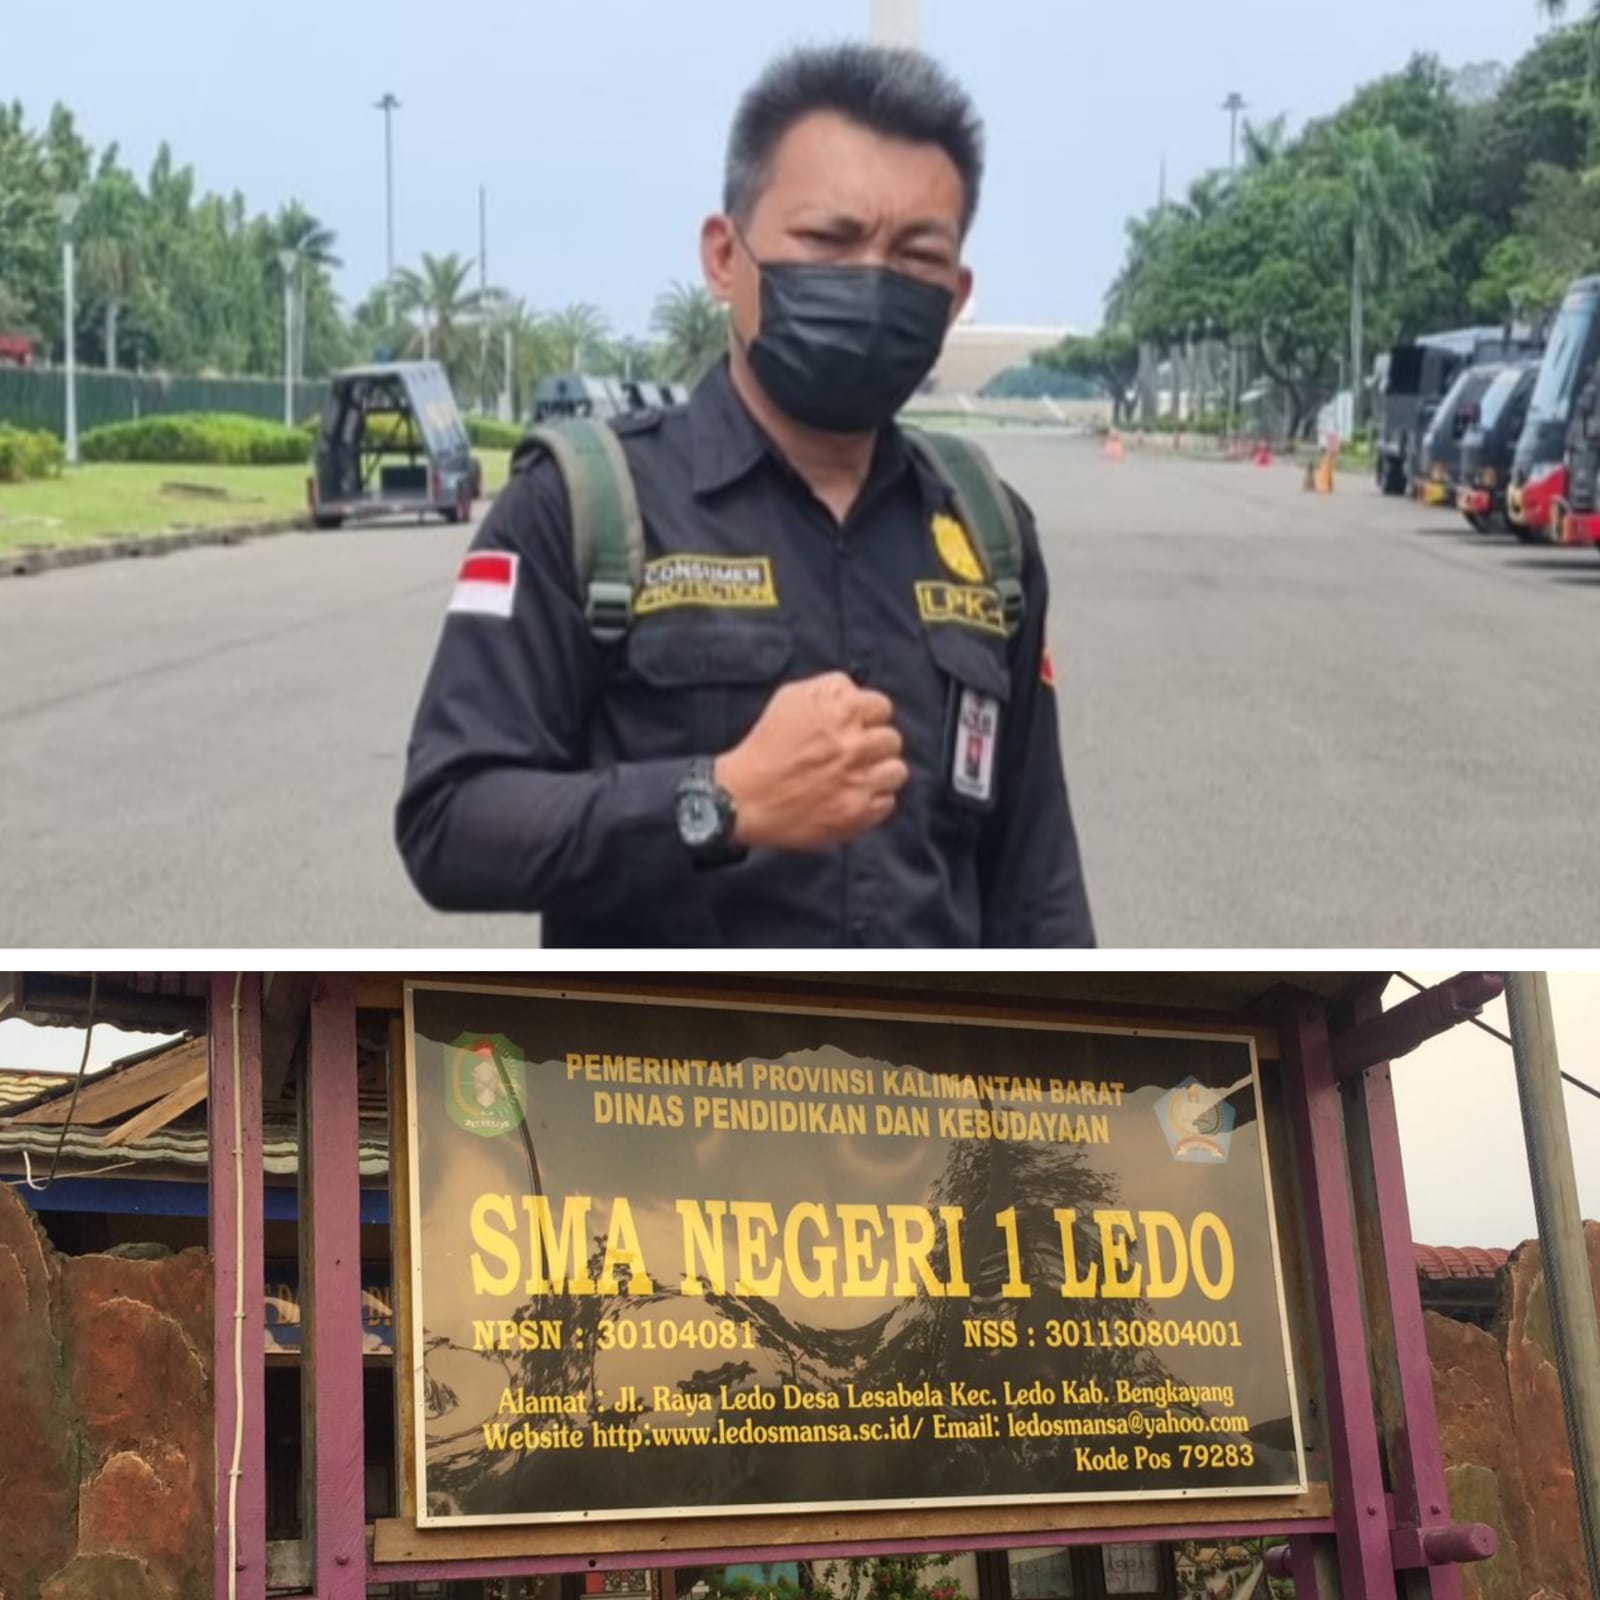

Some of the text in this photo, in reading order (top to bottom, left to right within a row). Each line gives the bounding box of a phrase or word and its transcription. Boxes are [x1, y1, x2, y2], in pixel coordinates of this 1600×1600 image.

[644, 562, 761, 587] CONSUMER
[566, 1053, 1124, 1107] PEMERINTAH PROVINSI KALIMANTAN BARAT
[594, 1092, 1109, 1144] DINAS PENDIDIKAN DAN KEBUDAYAAN
[470, 1193, 1234, 1300] SMA NEGERI 1 LEDO
[472, 1320, 562, 1351] NPSN
[597, 1319, 756, 1350] 30104081
[963, 1319, 1017, 1347] NSS
[1045, 1319, 1242, 1347] 301130804001
[498, 1387, 586, 1414] Alamat
[614, 1386, 645, 1413] Jl.
[653, 1386, 712, 1416] Raya
[720, 1384, 775, 1411] Ledo
[783, 1384, 839, 1410] Desa
[847, 1382, 943, 1408] Lesabela
[951, 1382, 997, 1407] Kec.
[1004, 1380, 1055, 1406] Ledo
[1062, 1379, 1109, 1405] Kab.
[1116, 1379, 1234, 1409] Bengkayang
[483, 1422, 584, 1451] Website
[933, 1413, 1000, 1439] Email:
[1008, 1410, 1249, 1439] ledosmansa@yahoo.com
[1075, 1444, 1254, 1472] Kode Pos 79283
